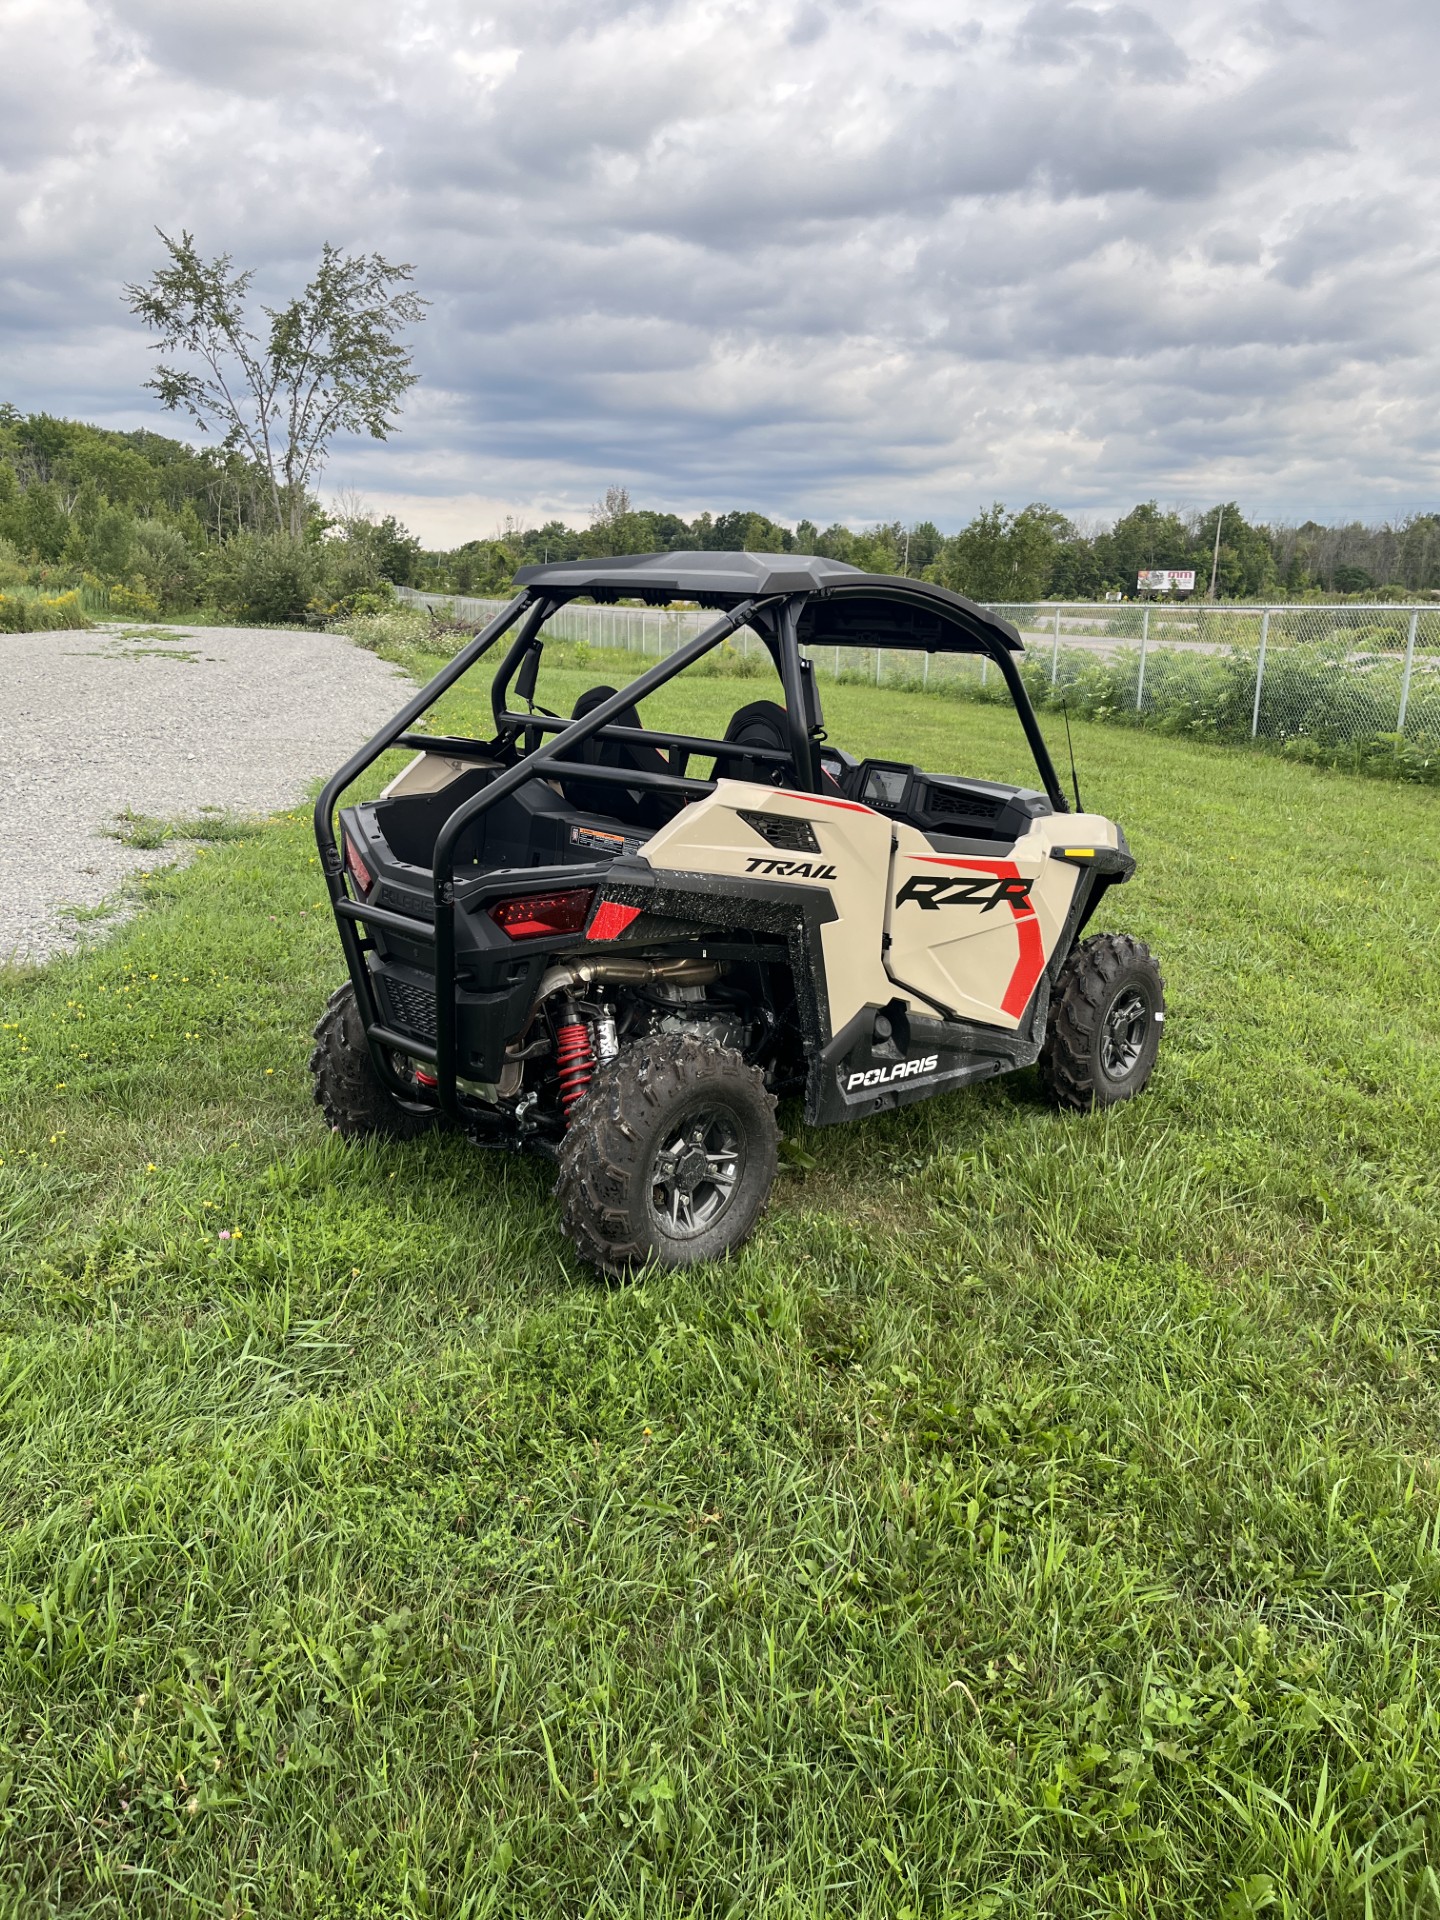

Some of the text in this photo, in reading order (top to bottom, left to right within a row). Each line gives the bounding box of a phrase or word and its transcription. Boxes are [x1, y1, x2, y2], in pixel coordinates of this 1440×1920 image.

[745, 858, 838, 880] TRAIL
[896, 876, 1034, 914] RZR
[847, 1054, 938, 1090] POLARIS
